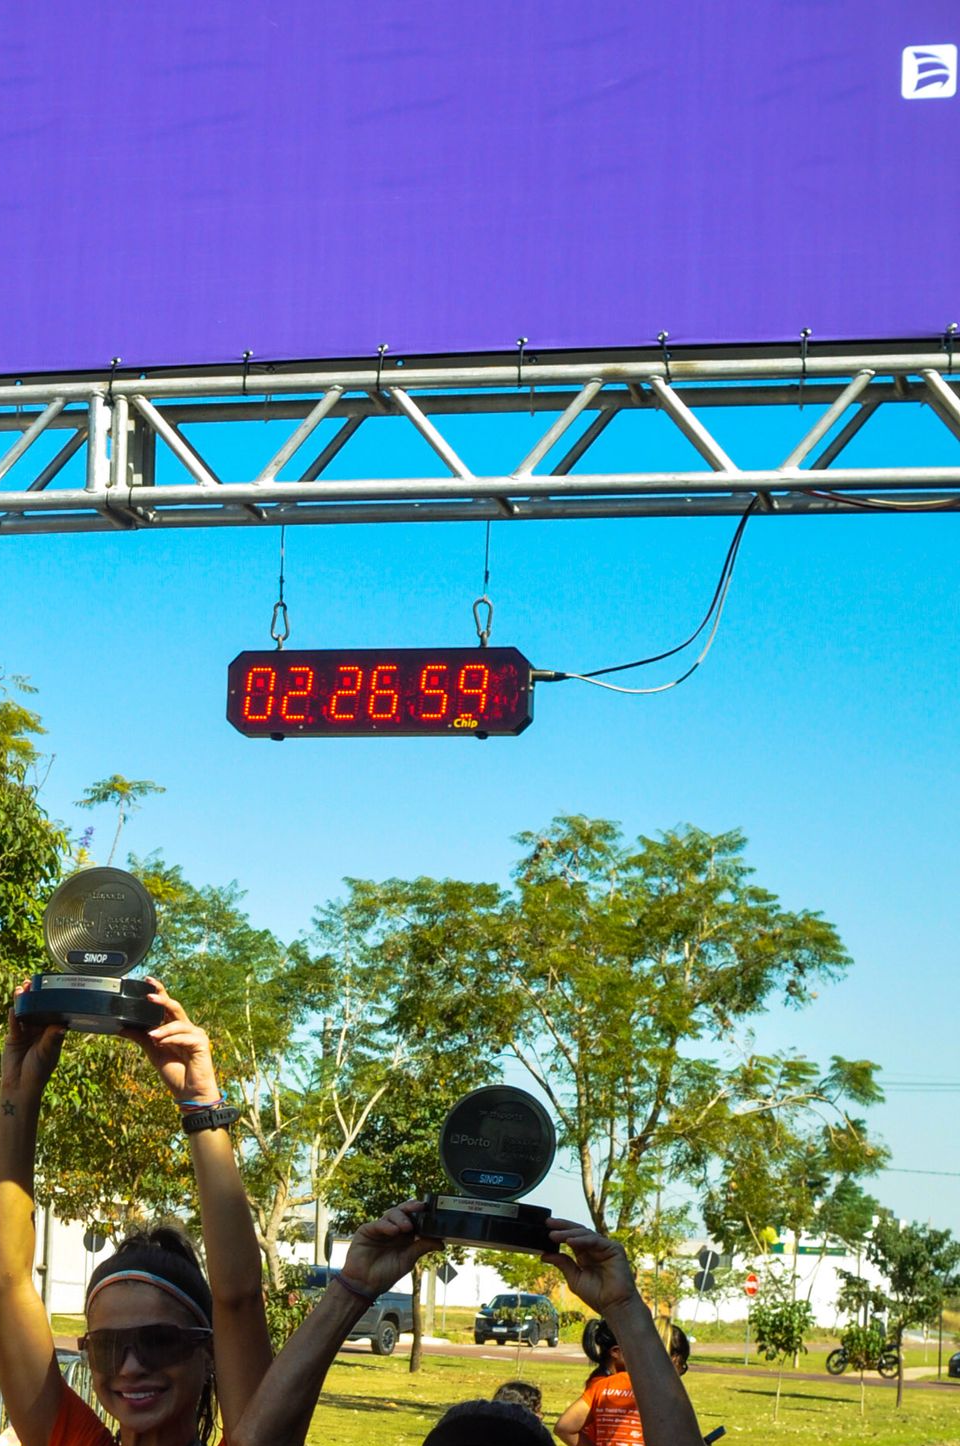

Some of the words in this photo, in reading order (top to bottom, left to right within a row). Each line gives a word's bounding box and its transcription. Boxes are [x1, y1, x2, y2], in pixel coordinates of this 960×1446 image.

[243, 666, 314, 720] 02
[330, 664, 400, 720] 26
[420, 663, 490, 719] 59
[453, 718, 478, 729] Chip
[83, 953, 108, 964] SINOP
[479, 1174, 504, 1185] SINOP
